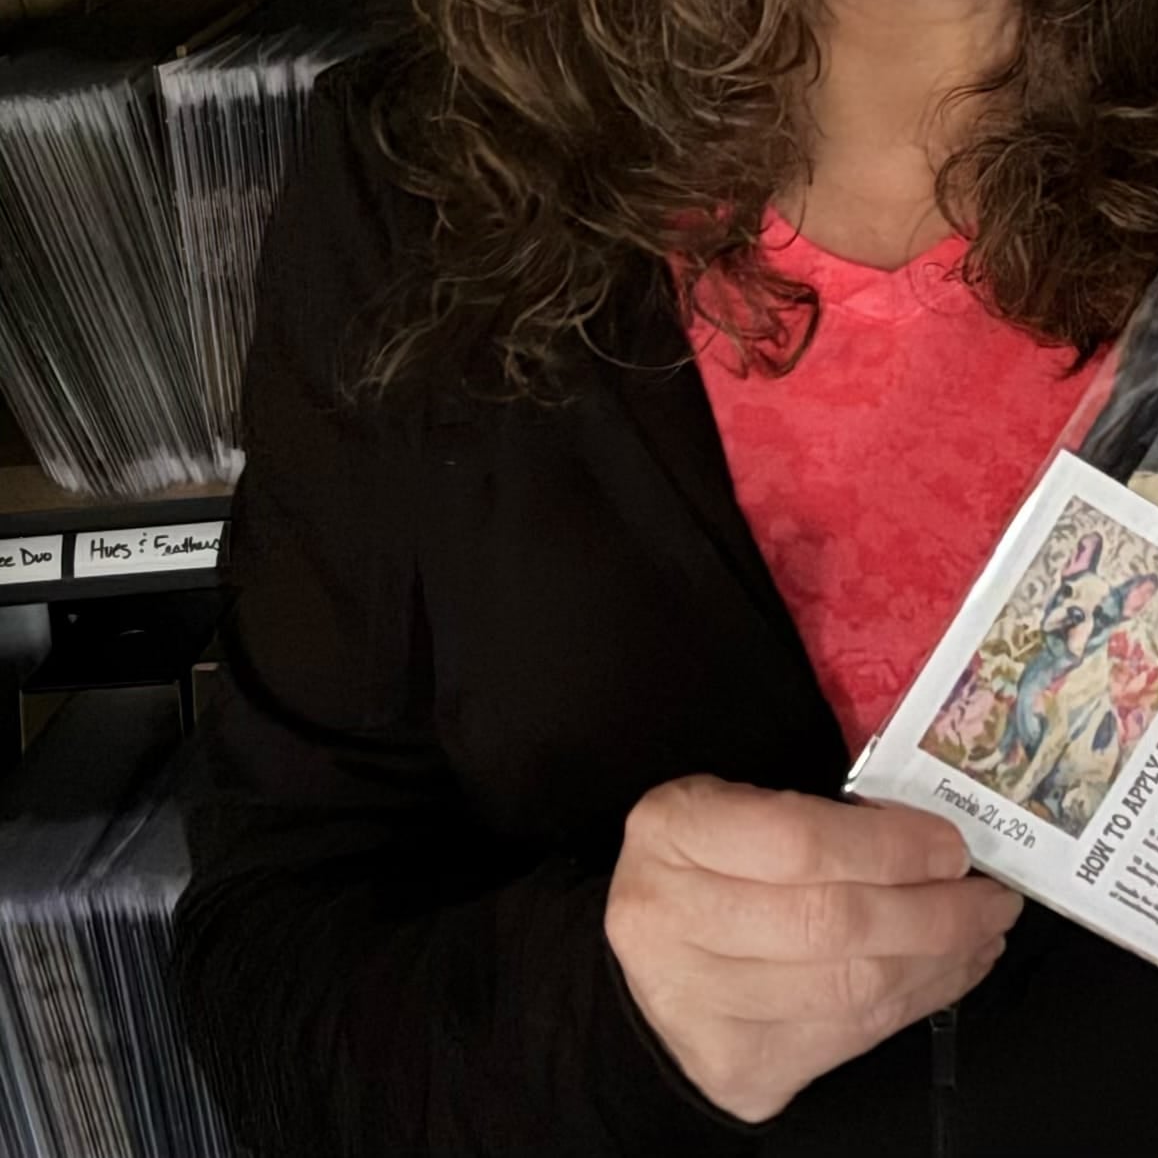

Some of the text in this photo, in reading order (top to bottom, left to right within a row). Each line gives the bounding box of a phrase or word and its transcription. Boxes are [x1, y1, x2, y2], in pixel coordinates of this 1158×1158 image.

[20, 547, 53, 566] Duo
[90, 537, 132, 562] Hues
[992, 817, 1006, 832] x
[1002, 817, 1029, 842] 29
[1075, 838, 1116, 885] HOW
[1102, 813, 1132, 840] TO
